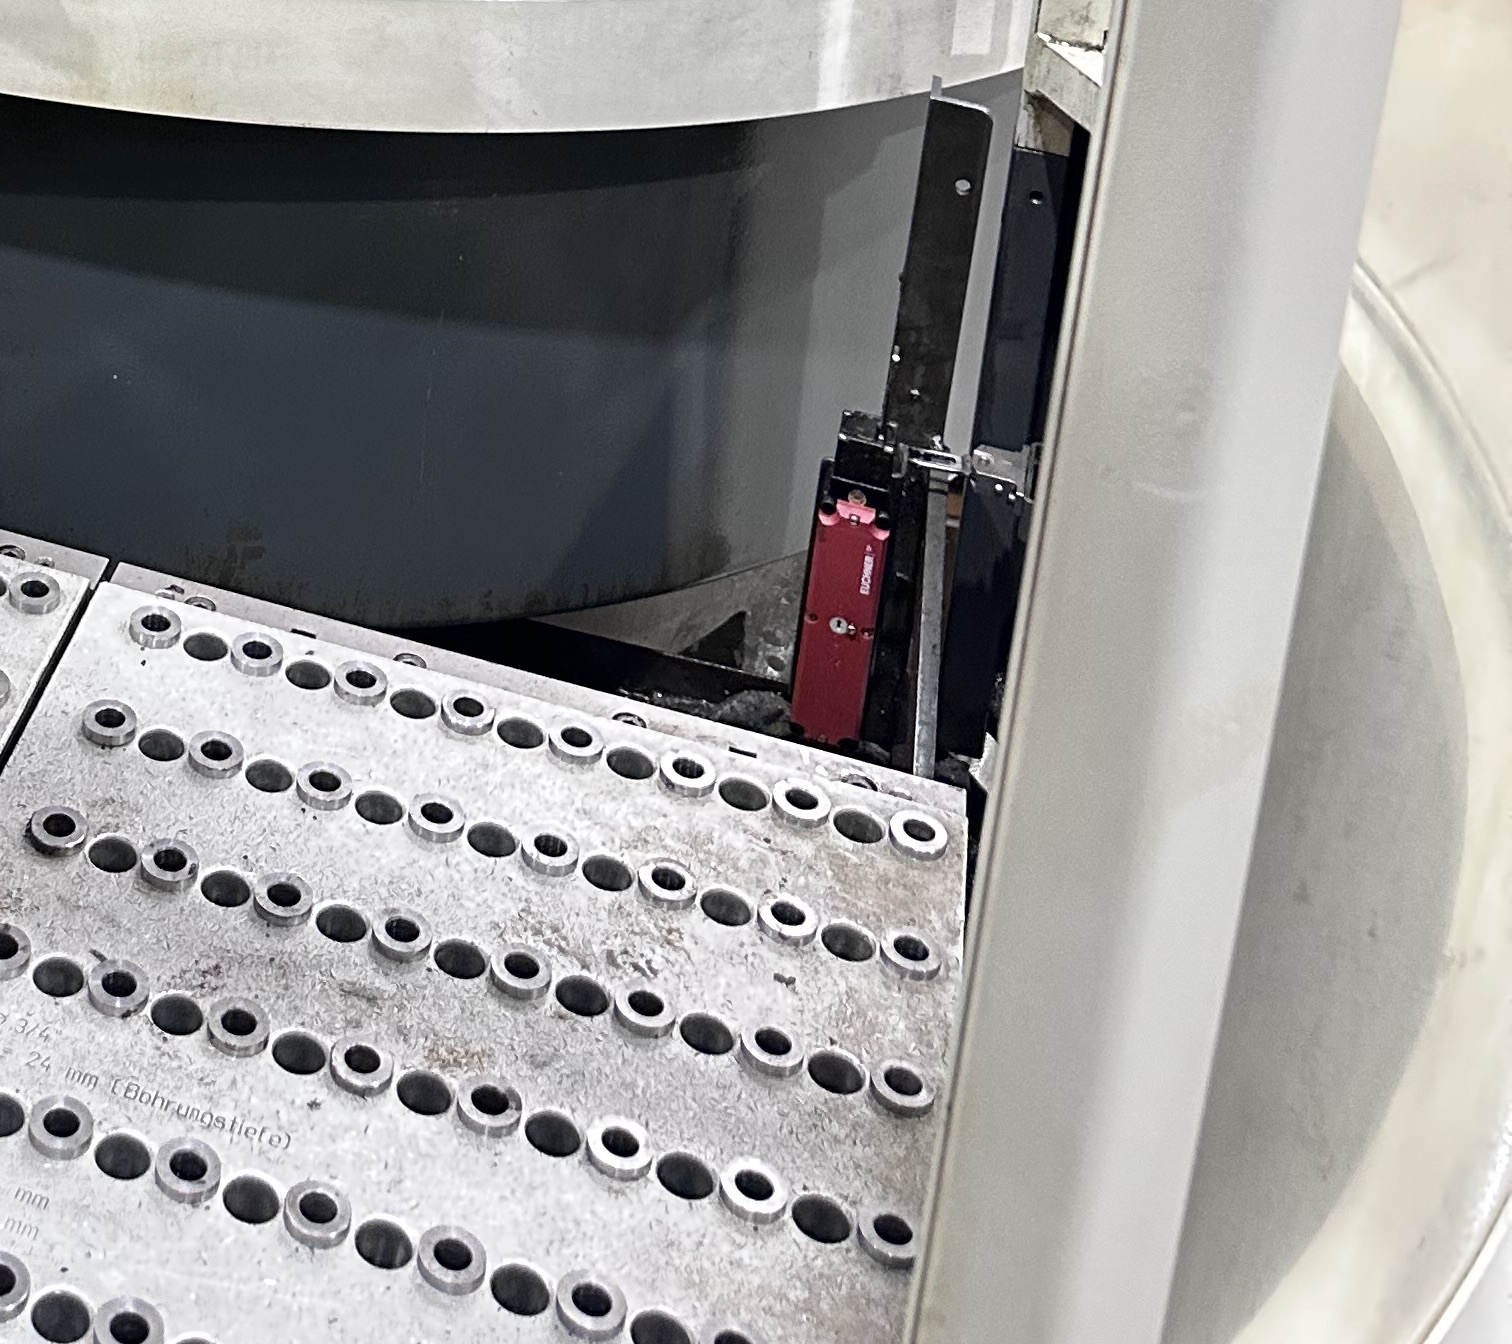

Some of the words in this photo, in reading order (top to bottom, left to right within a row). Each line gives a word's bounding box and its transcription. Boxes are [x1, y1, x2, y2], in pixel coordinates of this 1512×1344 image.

[25, 1050, 52, 1073] 24
[64, 1066, 100, 1089] mm
[110, 1077, 292, 1151] (Bohrungstiefe)
[13, 1185, 50, 1211] mm
[3, 1216, 40, 1241] mm
